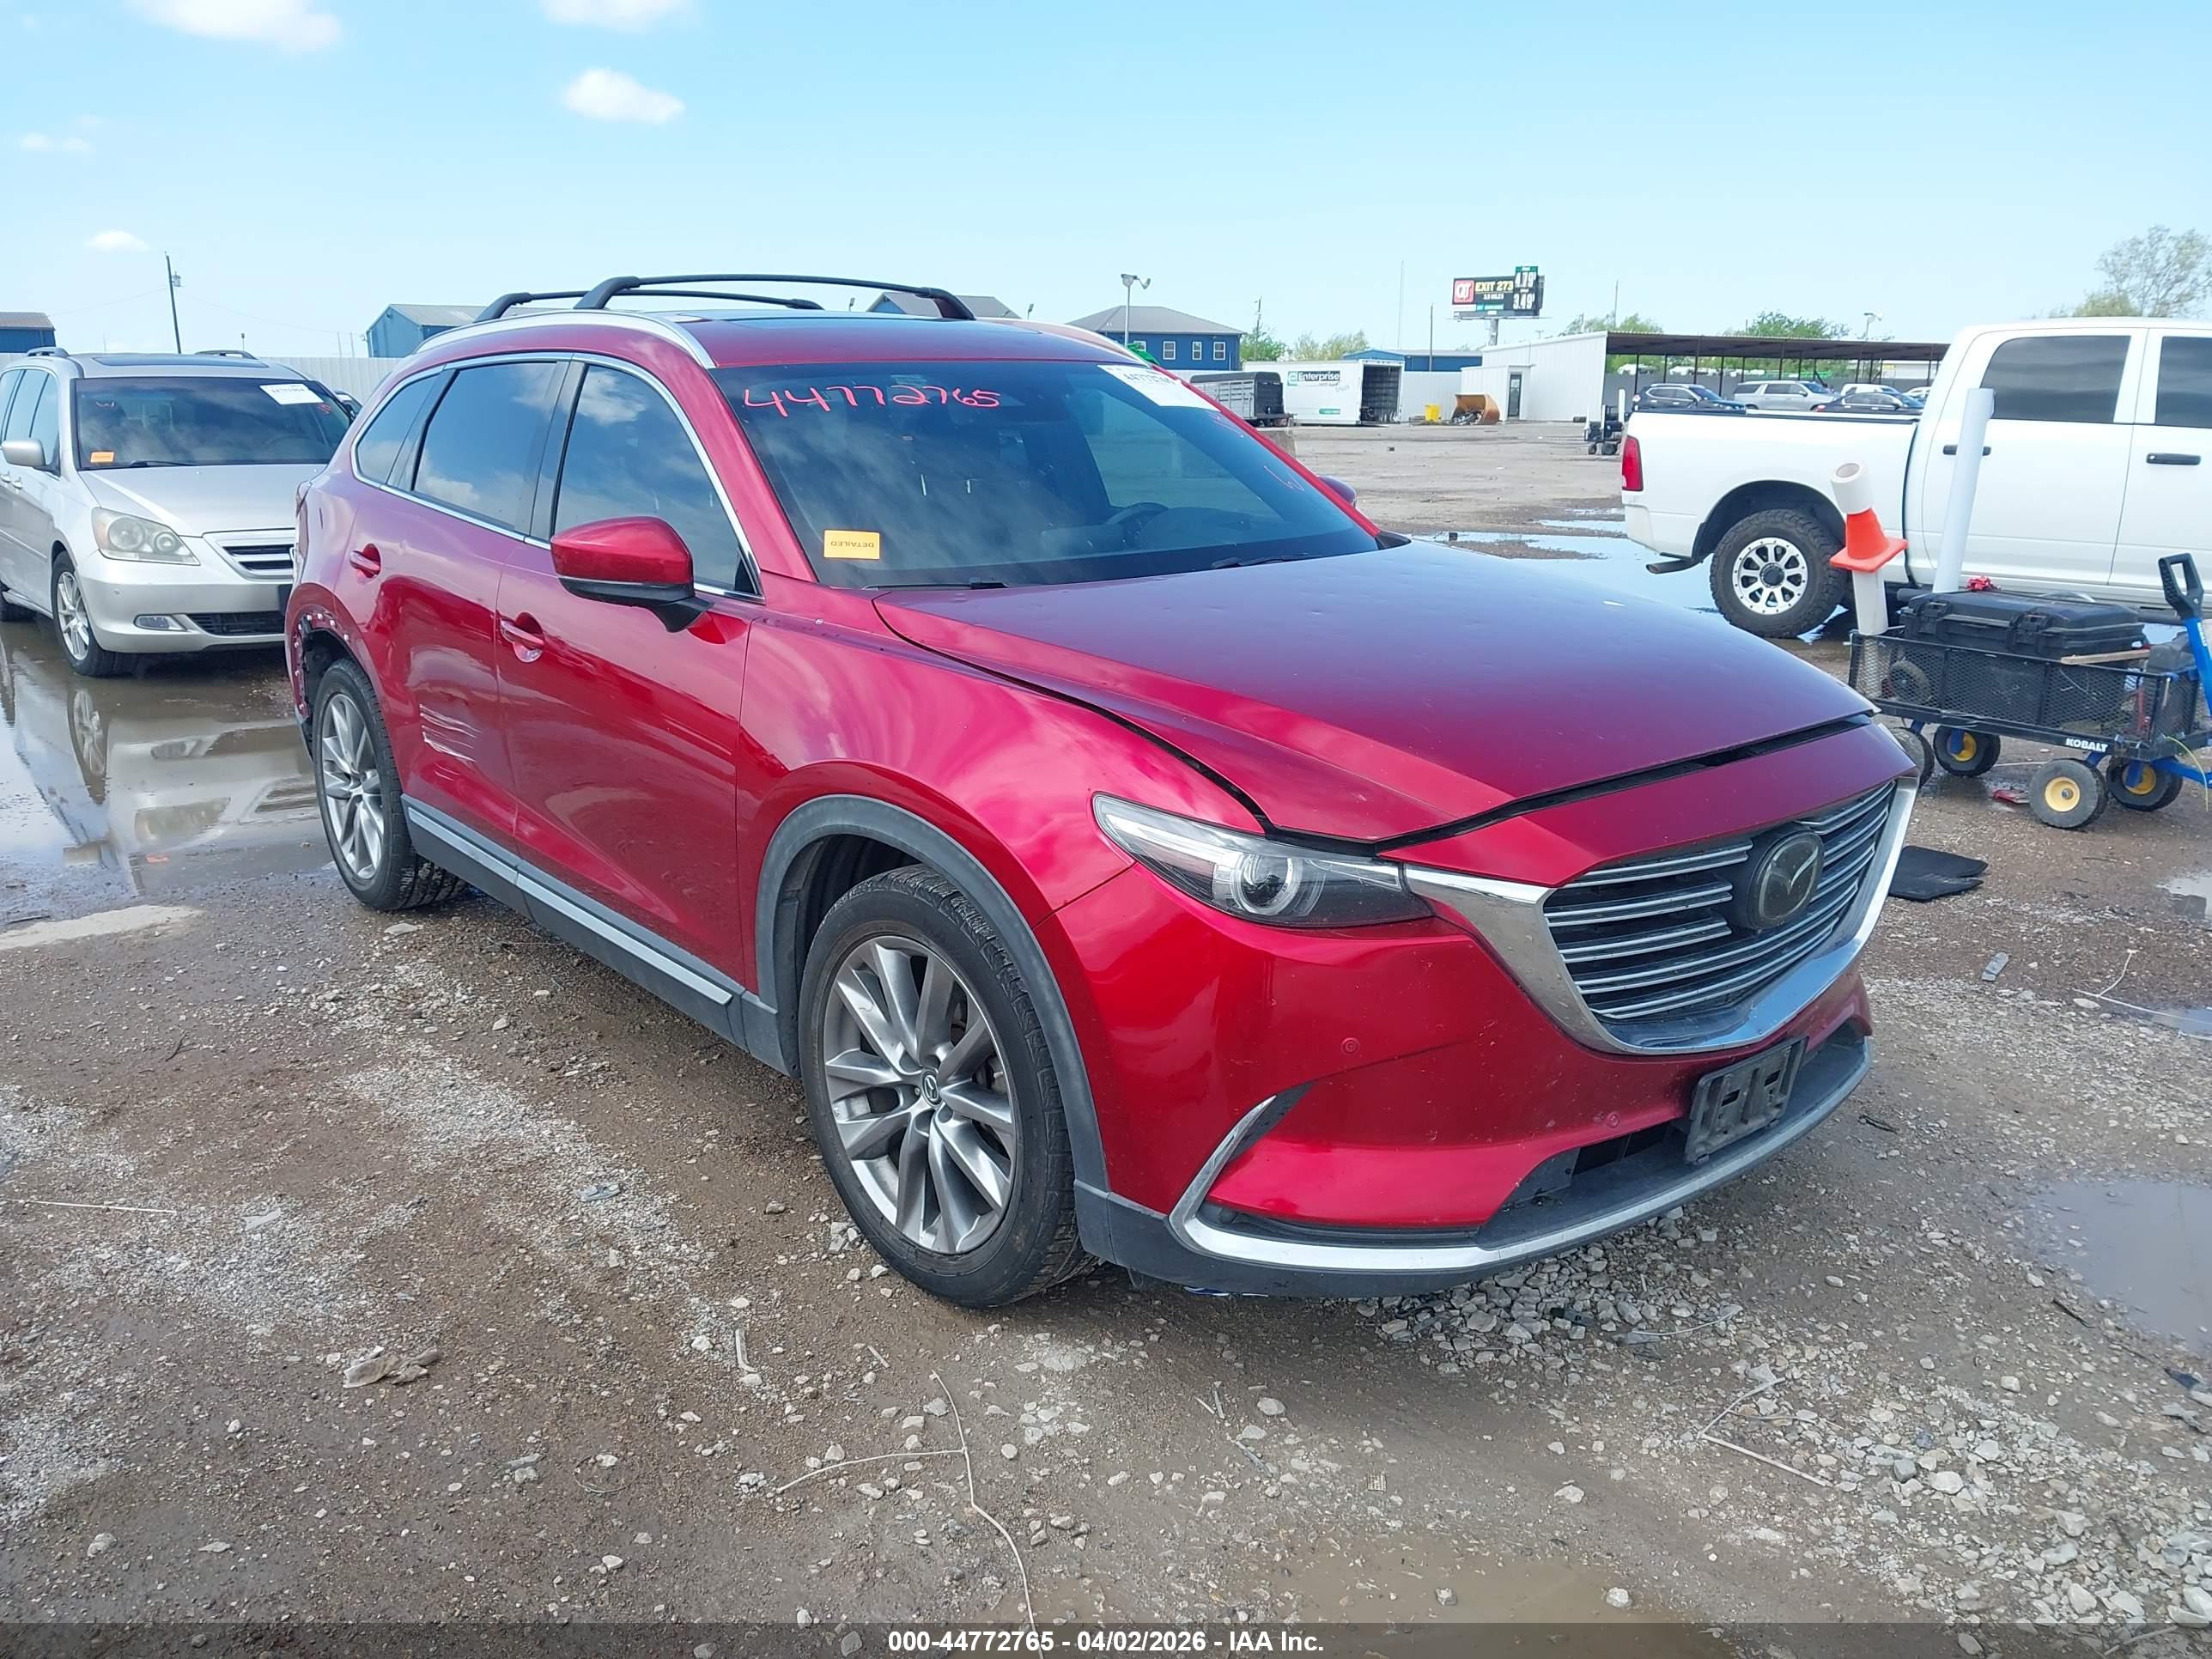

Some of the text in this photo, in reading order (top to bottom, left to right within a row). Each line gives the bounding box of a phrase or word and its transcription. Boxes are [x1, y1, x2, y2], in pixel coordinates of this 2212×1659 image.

[1475, 281, 1495, 292] EXIT
[1298, 371, 1340, 381] Enterprise
[744, 386, 1000, 418] 44772765
[830, 540, 875, 549] DETAILED
[2065, 738, 2109, 753] KOBALT
